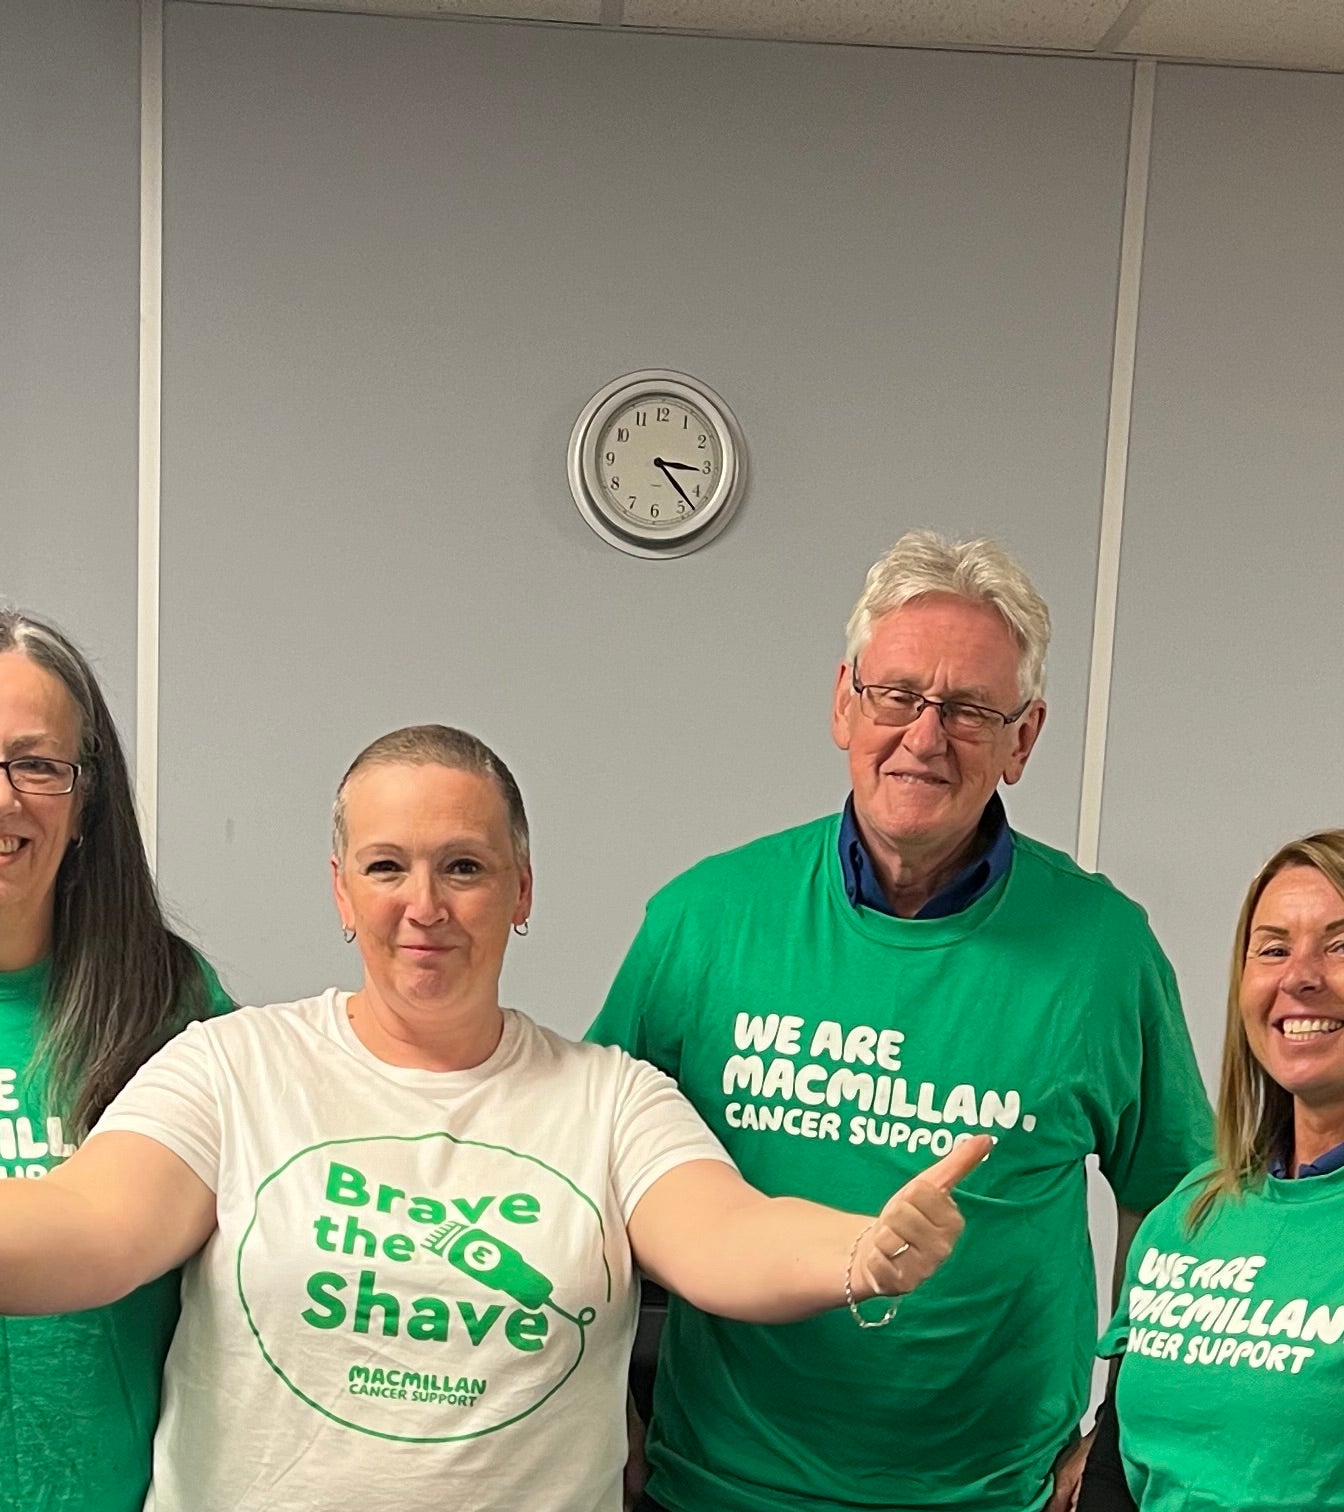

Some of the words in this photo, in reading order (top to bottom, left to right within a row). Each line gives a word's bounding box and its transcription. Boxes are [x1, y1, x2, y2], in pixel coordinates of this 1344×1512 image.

[636, 412, 647, 427] 11
[656, 407, 670, 422] 12
[617, 427, 630, 442] 10
[697, 434, 707, 449] 2
[606, 451, 616, 466] 9
[702, 460, 712, 475] 3
[610, 476, 620, 490] 8
[692, 484, 701, 498] 4
[628, 496, 637, 510] 7
[650, 503, 660, 518] 6
[676, 500, 686, 514] 5
[735, 1012, 805, 1056] WE
[810, 1020, 906, 1072] ARE
[722, 1054, 1037, 1132] MACMILLAN.
[725, 1102, 842, 1141] CANCER
[848, 1115, 999, 1162] SUPPO
[324, 1161, 541, 1225] Brave
[312, 1215, 417, 1263] the
[1137, 1247, 1199, 1290] WE
[1189, 1255, 1267, 1294] ARE
[301, 1270, 549, 1353] Shave
[1126, 1326, 1185, 1361] NCER
[1183, 1335, 1316, 1374] SUPPORT
[348, 1365, 488, 1395] MACMILLAN
[348, 1384, 408, 1401] CANCER
[412, 1390, 478, 1408] SUPPORT
